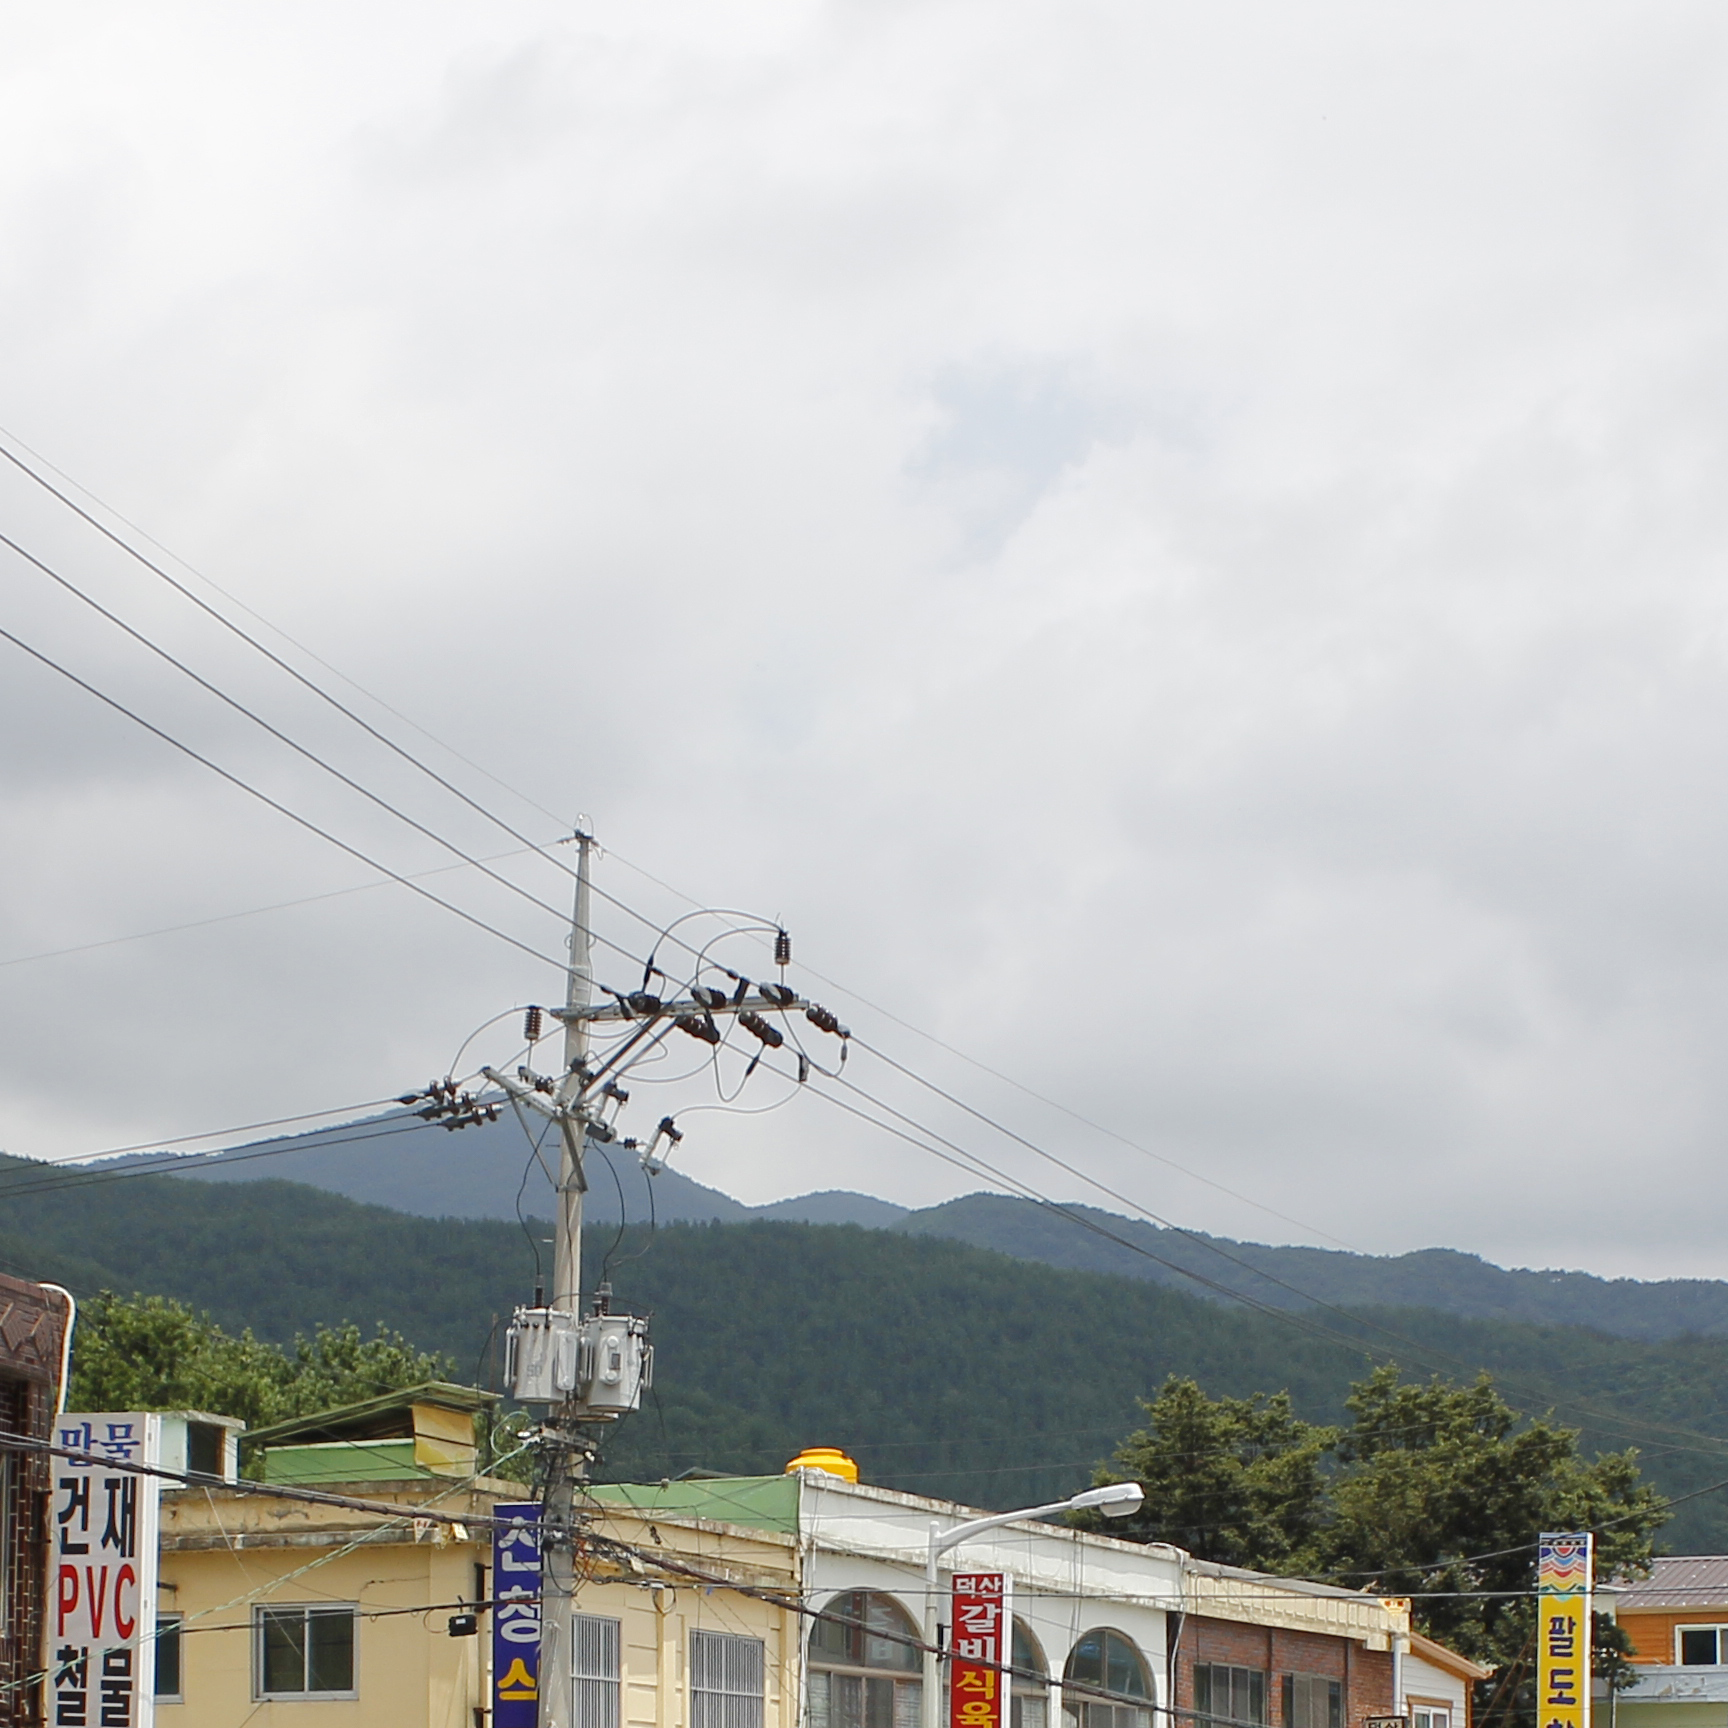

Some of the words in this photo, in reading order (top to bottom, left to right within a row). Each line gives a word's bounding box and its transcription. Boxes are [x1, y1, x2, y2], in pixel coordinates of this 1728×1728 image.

[59, 1422, 140, 1468] 만물
[57, 1476, 137, 1558] 건재
[57, 1563, 137, 1640] PVC
[956, 1577, 1002, 1599] 덕산
[54, 1644, 133, 1728] 철물
